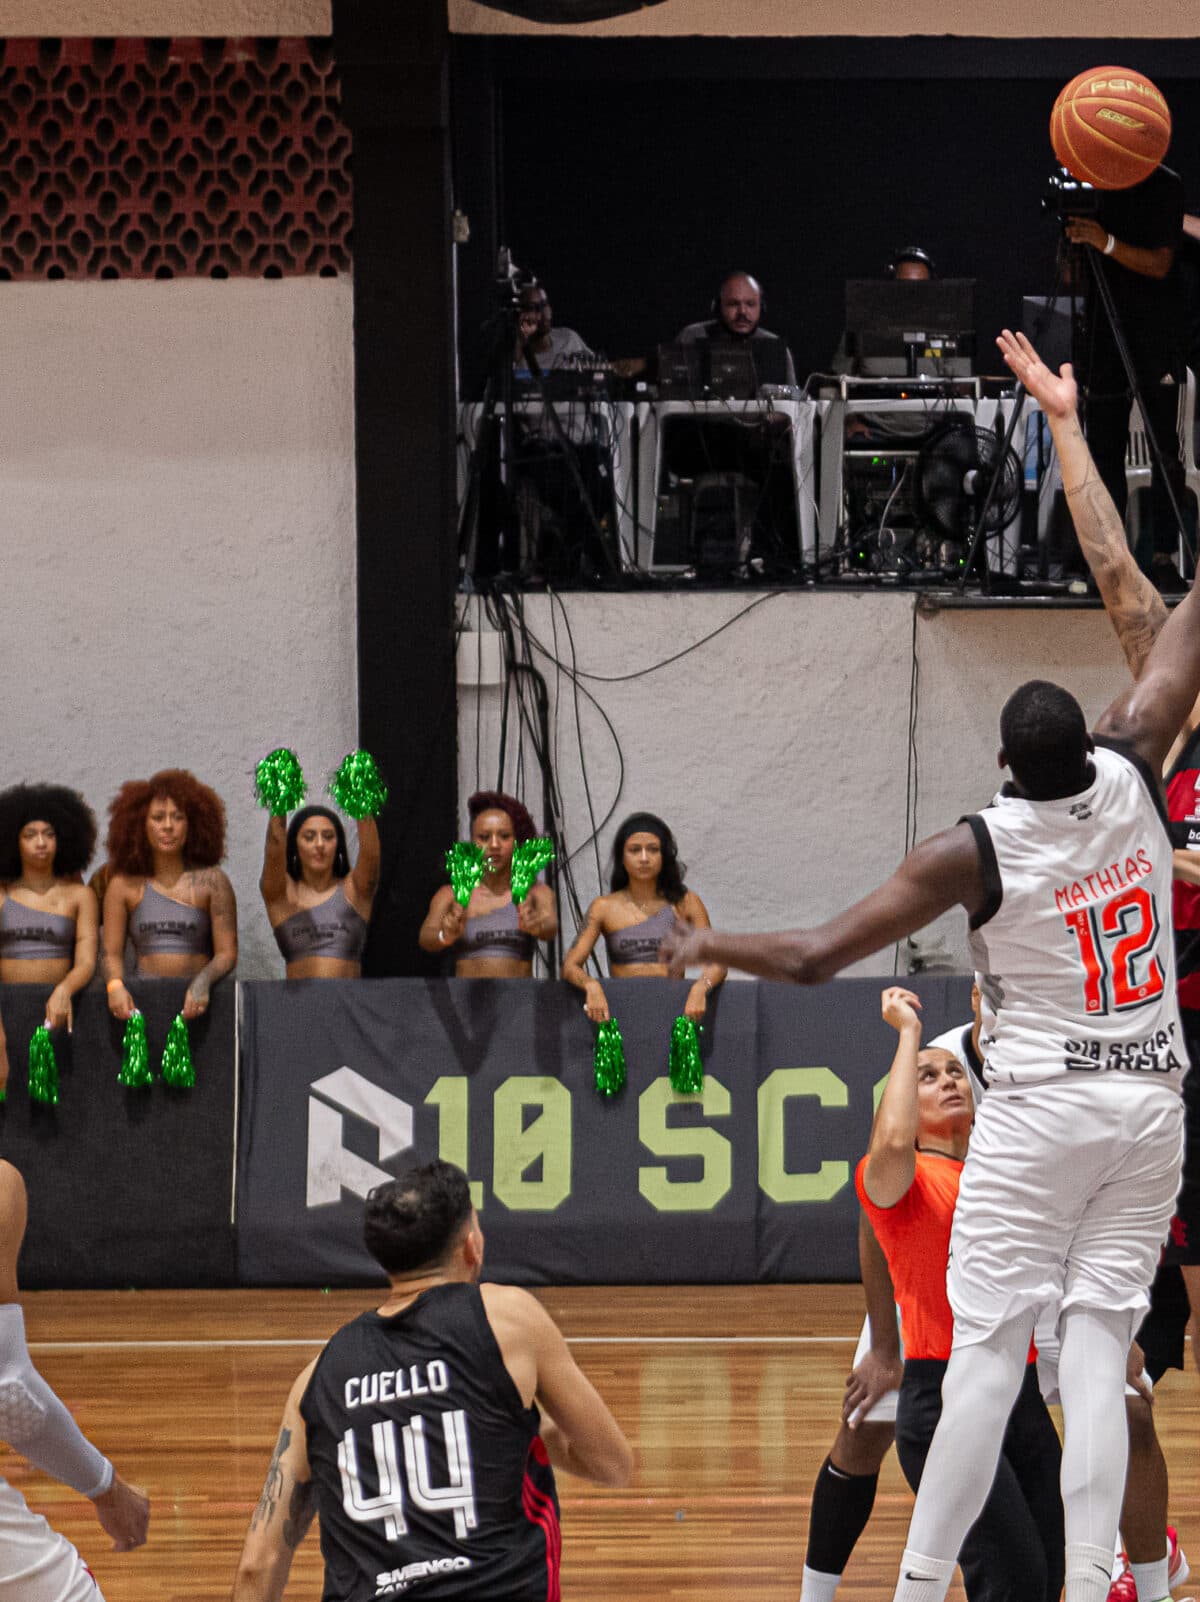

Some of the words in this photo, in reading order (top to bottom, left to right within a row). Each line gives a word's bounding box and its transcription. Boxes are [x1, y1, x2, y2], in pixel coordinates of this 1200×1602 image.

[1054, 849, 1154, 911] MATHIAS
[1064, 886, 1166, 1016] 12
[639, 1066, 892, 1211] SC
[344, 1359, 450, 1409] CUELLO
[337, 1409, 478, 1542] 44
